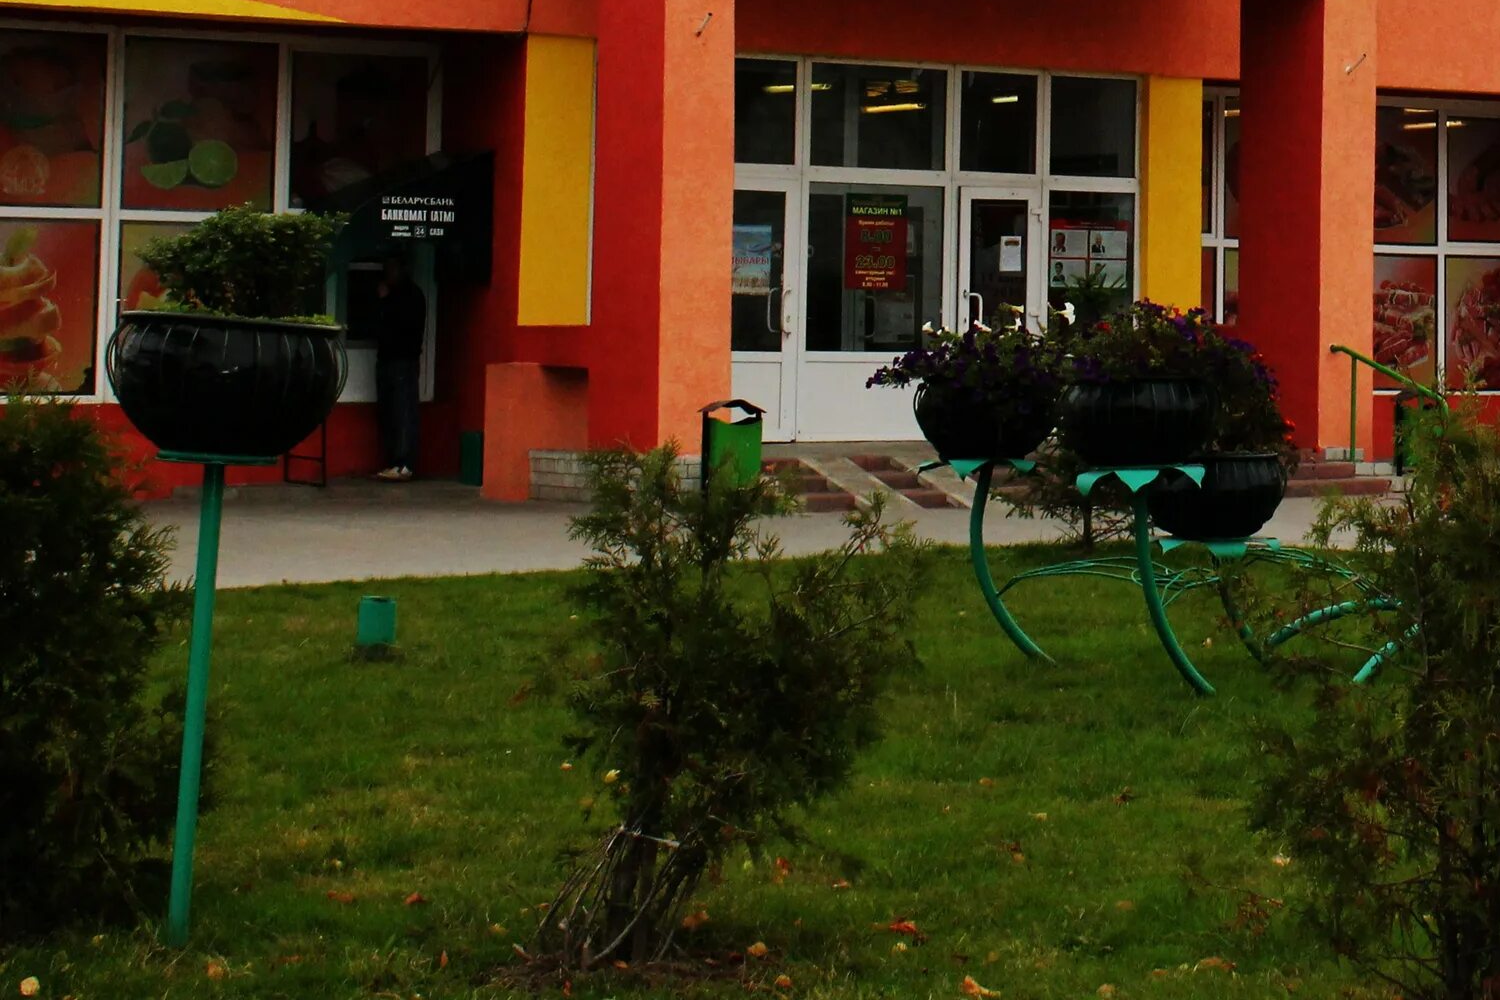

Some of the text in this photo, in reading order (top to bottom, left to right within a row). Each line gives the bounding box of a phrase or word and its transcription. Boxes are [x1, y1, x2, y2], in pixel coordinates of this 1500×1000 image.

[391, 196, 455, 206] БЕЛАРУСБАНК
[381, 208, 427, 221] БАНКОМАТ
[852, 206, 889, 216] МАГАЗИН
[415, 227, 425, 235] 24
